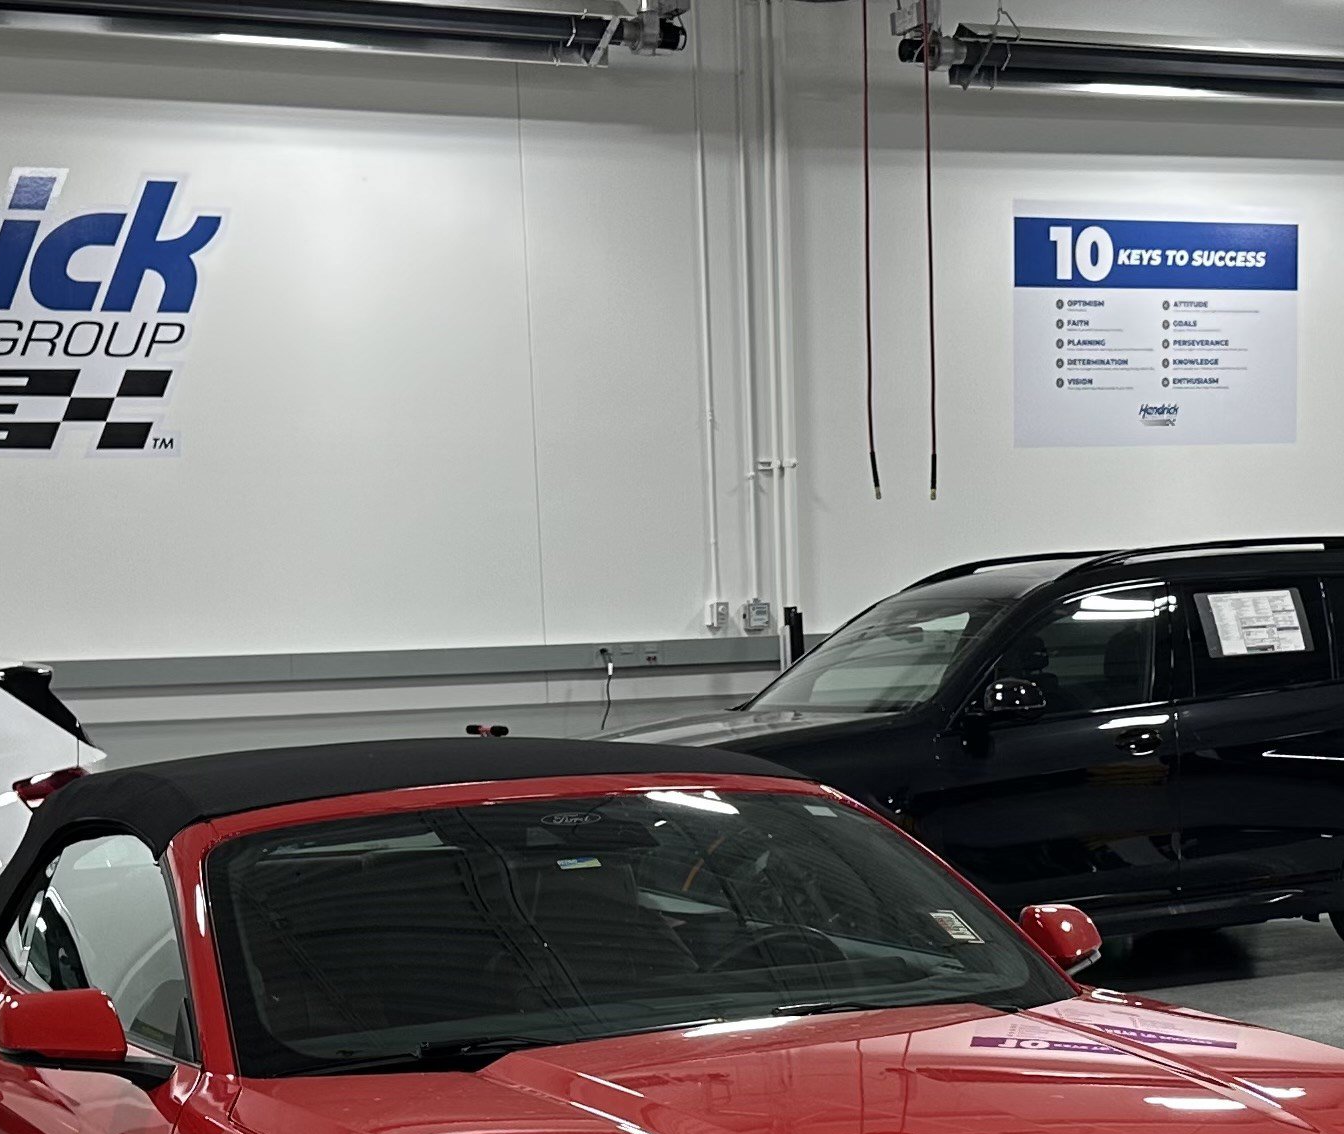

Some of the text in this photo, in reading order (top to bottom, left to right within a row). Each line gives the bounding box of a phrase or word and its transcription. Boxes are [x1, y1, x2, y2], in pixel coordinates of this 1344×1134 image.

[1049, 226, 1267, 282] 10 KEYS TO SUCCESS
[1067, 300, 1105, 308] OPTIMISM
[1067, 319, 1090, 327] FAITH
[1067, 339, 1106, 347] PLANNING
[1067, 358, 1129, 366] DETERMINATION
[1067, 378, 1093, 386] VISION
[152, 437, 174, 450] TM
